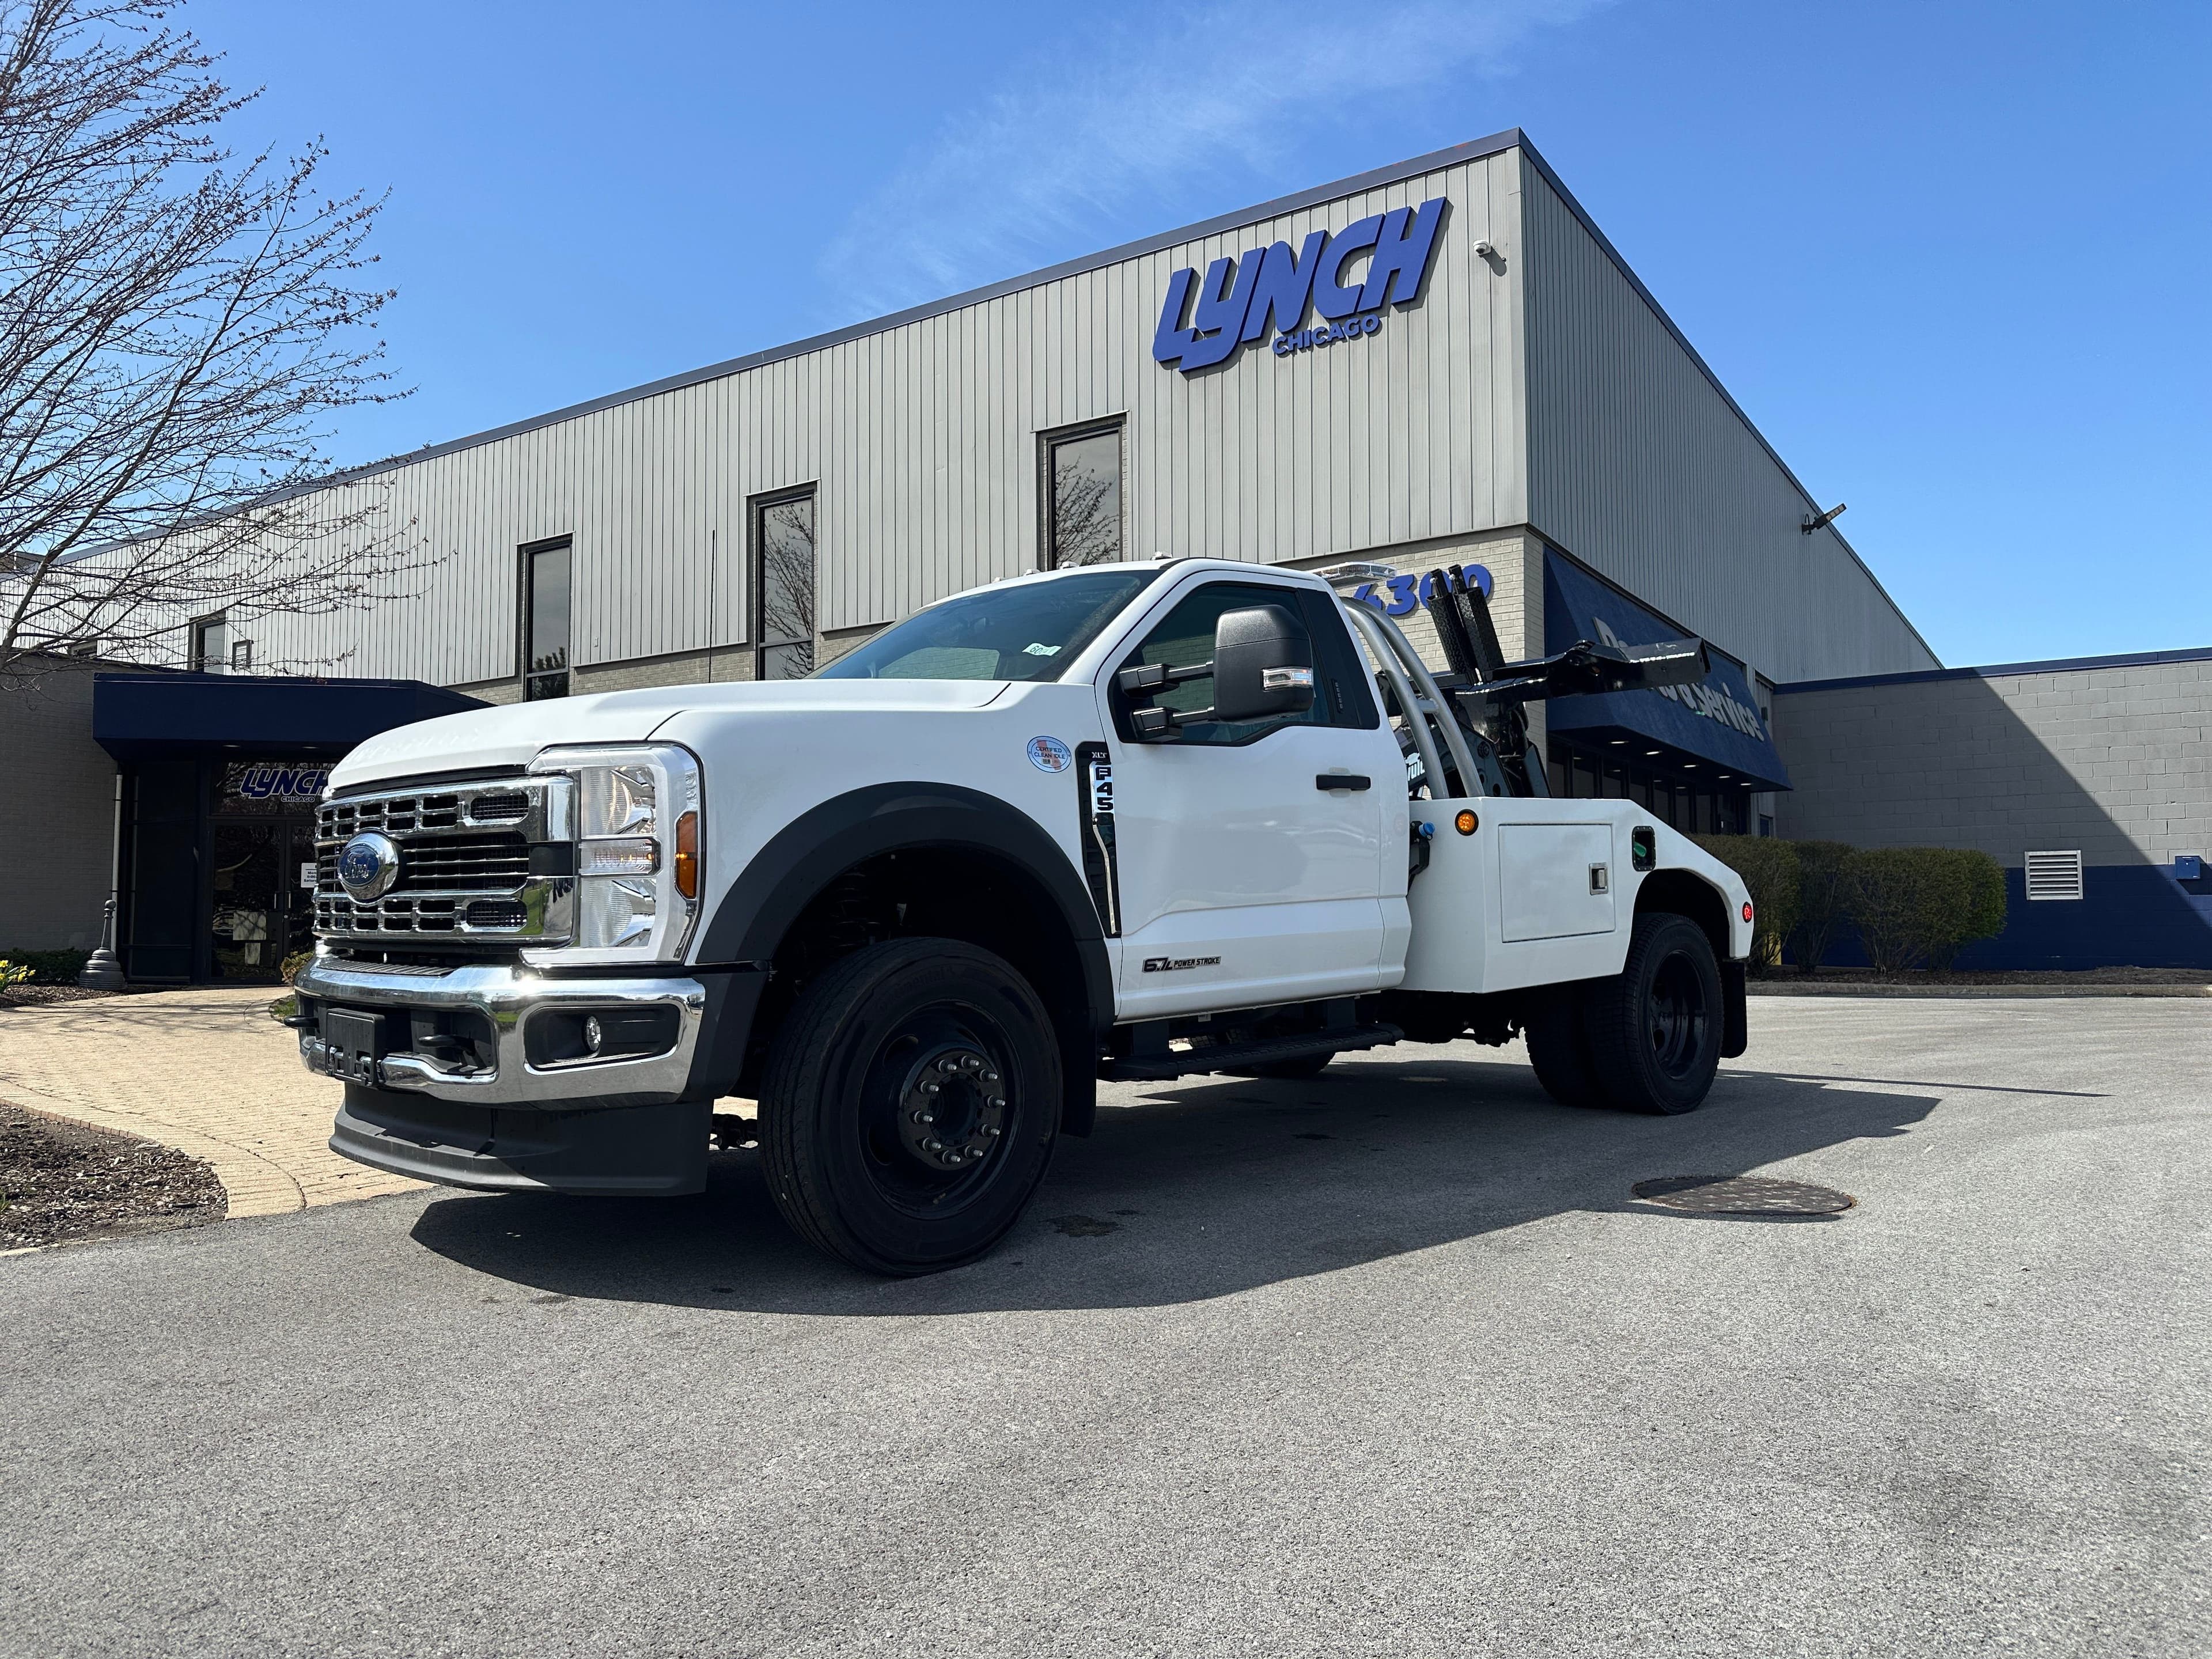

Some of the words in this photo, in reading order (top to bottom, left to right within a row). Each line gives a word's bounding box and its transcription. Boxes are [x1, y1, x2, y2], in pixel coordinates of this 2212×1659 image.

[1153, 196, 1448, 373] LYNCH
[1272, 313, 1381, 356] CHICAGO
[1691, 681, 1765, 743] Service
[240, 768, 332, 799] LYNCH
[1143, 957, 1173, 972] 6.7L
[1173, 959, 1195, 968] POWER
[1196, 956, 1220, 965] STROKE
